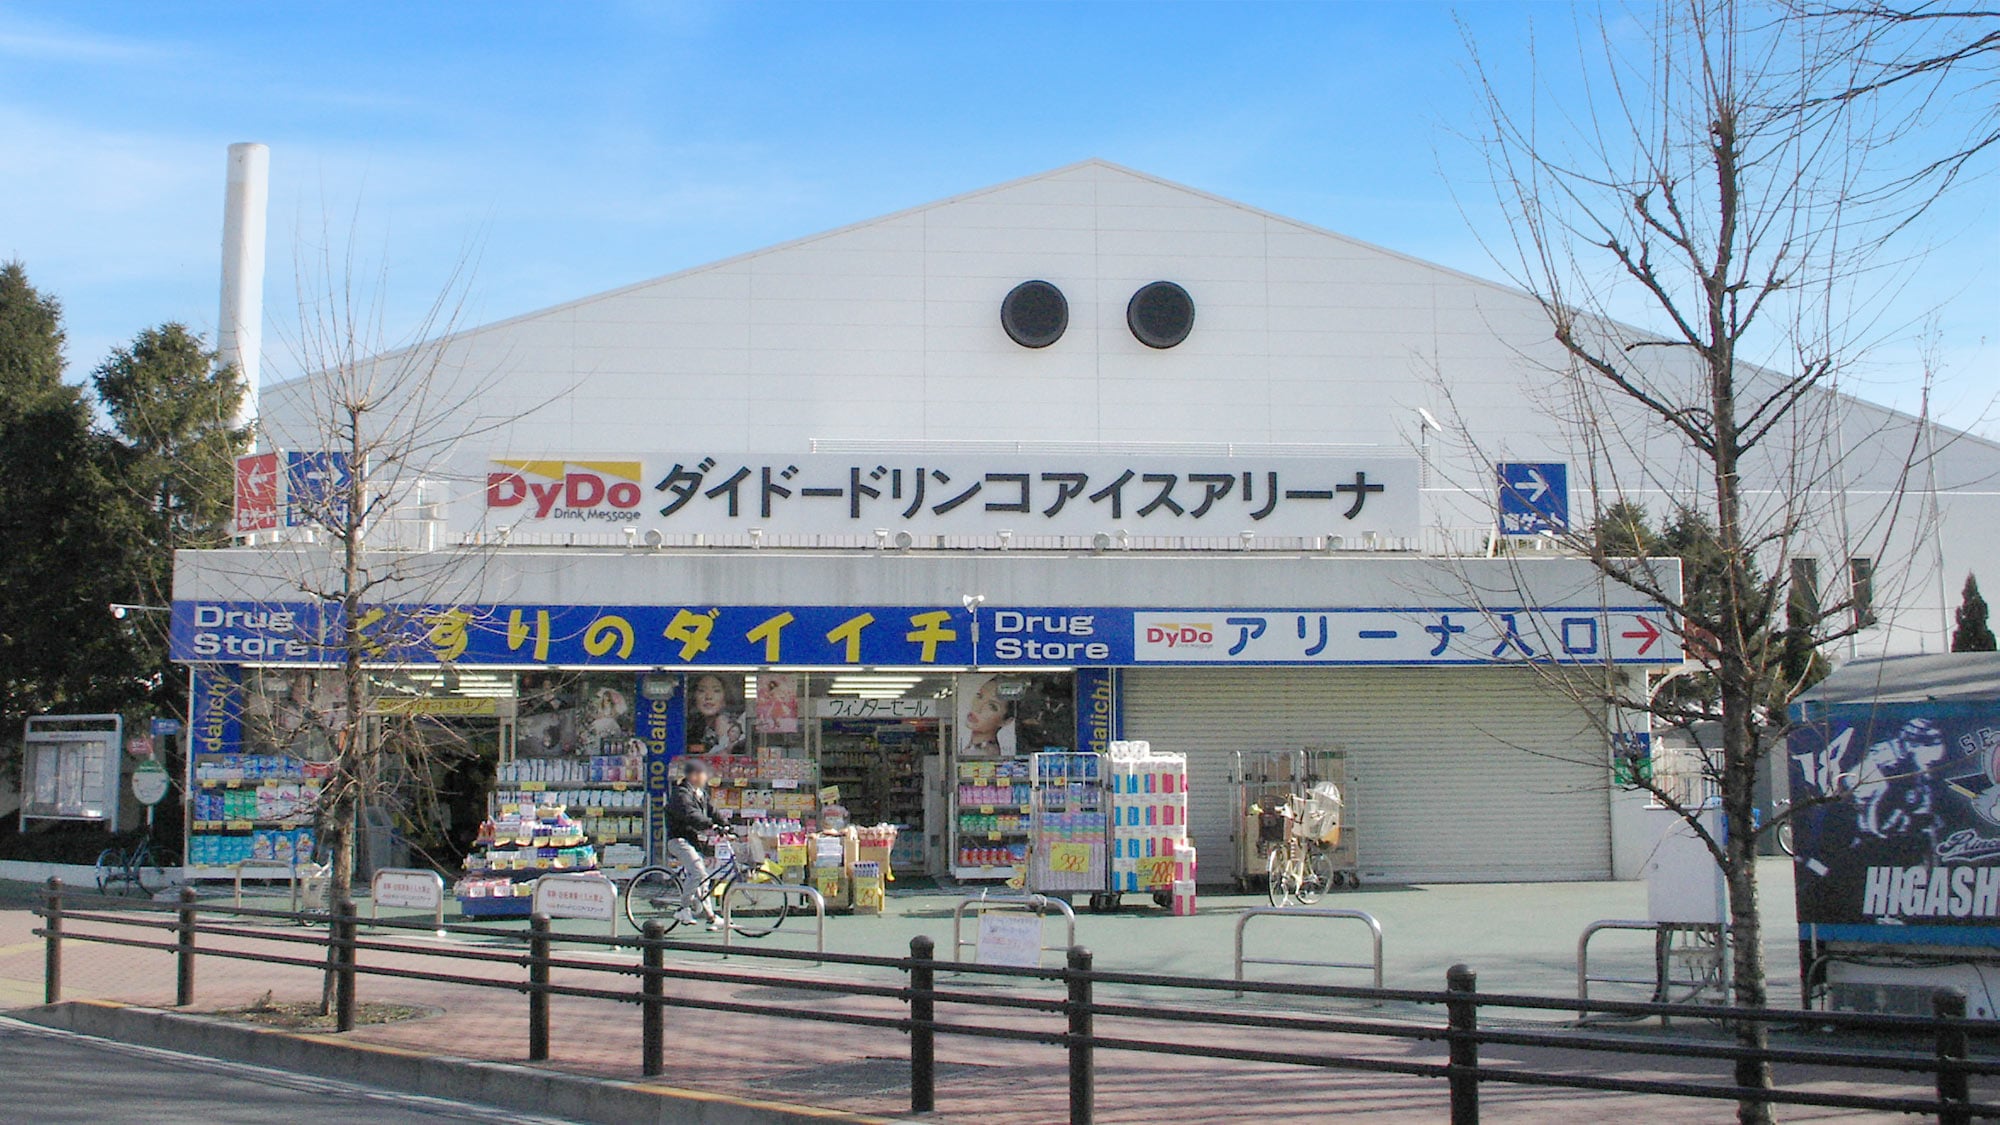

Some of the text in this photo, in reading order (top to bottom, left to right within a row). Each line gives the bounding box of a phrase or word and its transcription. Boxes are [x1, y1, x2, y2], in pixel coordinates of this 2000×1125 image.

[488, 472, 642, 518] DyDo
[655, 457, 1384, 520] ダイドードリンコアイスアリーナ
[554, 508, 641, 522] Drink Message
[194, 606, 296, 632] Drug
[995, 611, 1095, 635] Drug
[193, 633, 309, 656] Store
[1147, 628, 1213, 648] DyDo
[1226, 613, 1598, 657] アリーナ入口
[995, 637, 1109, 659] Store
[829, 699, 929, 717] ウィンターセール
[648, 700, 667, 754] daiic
[650, 761, 665, 789] no
